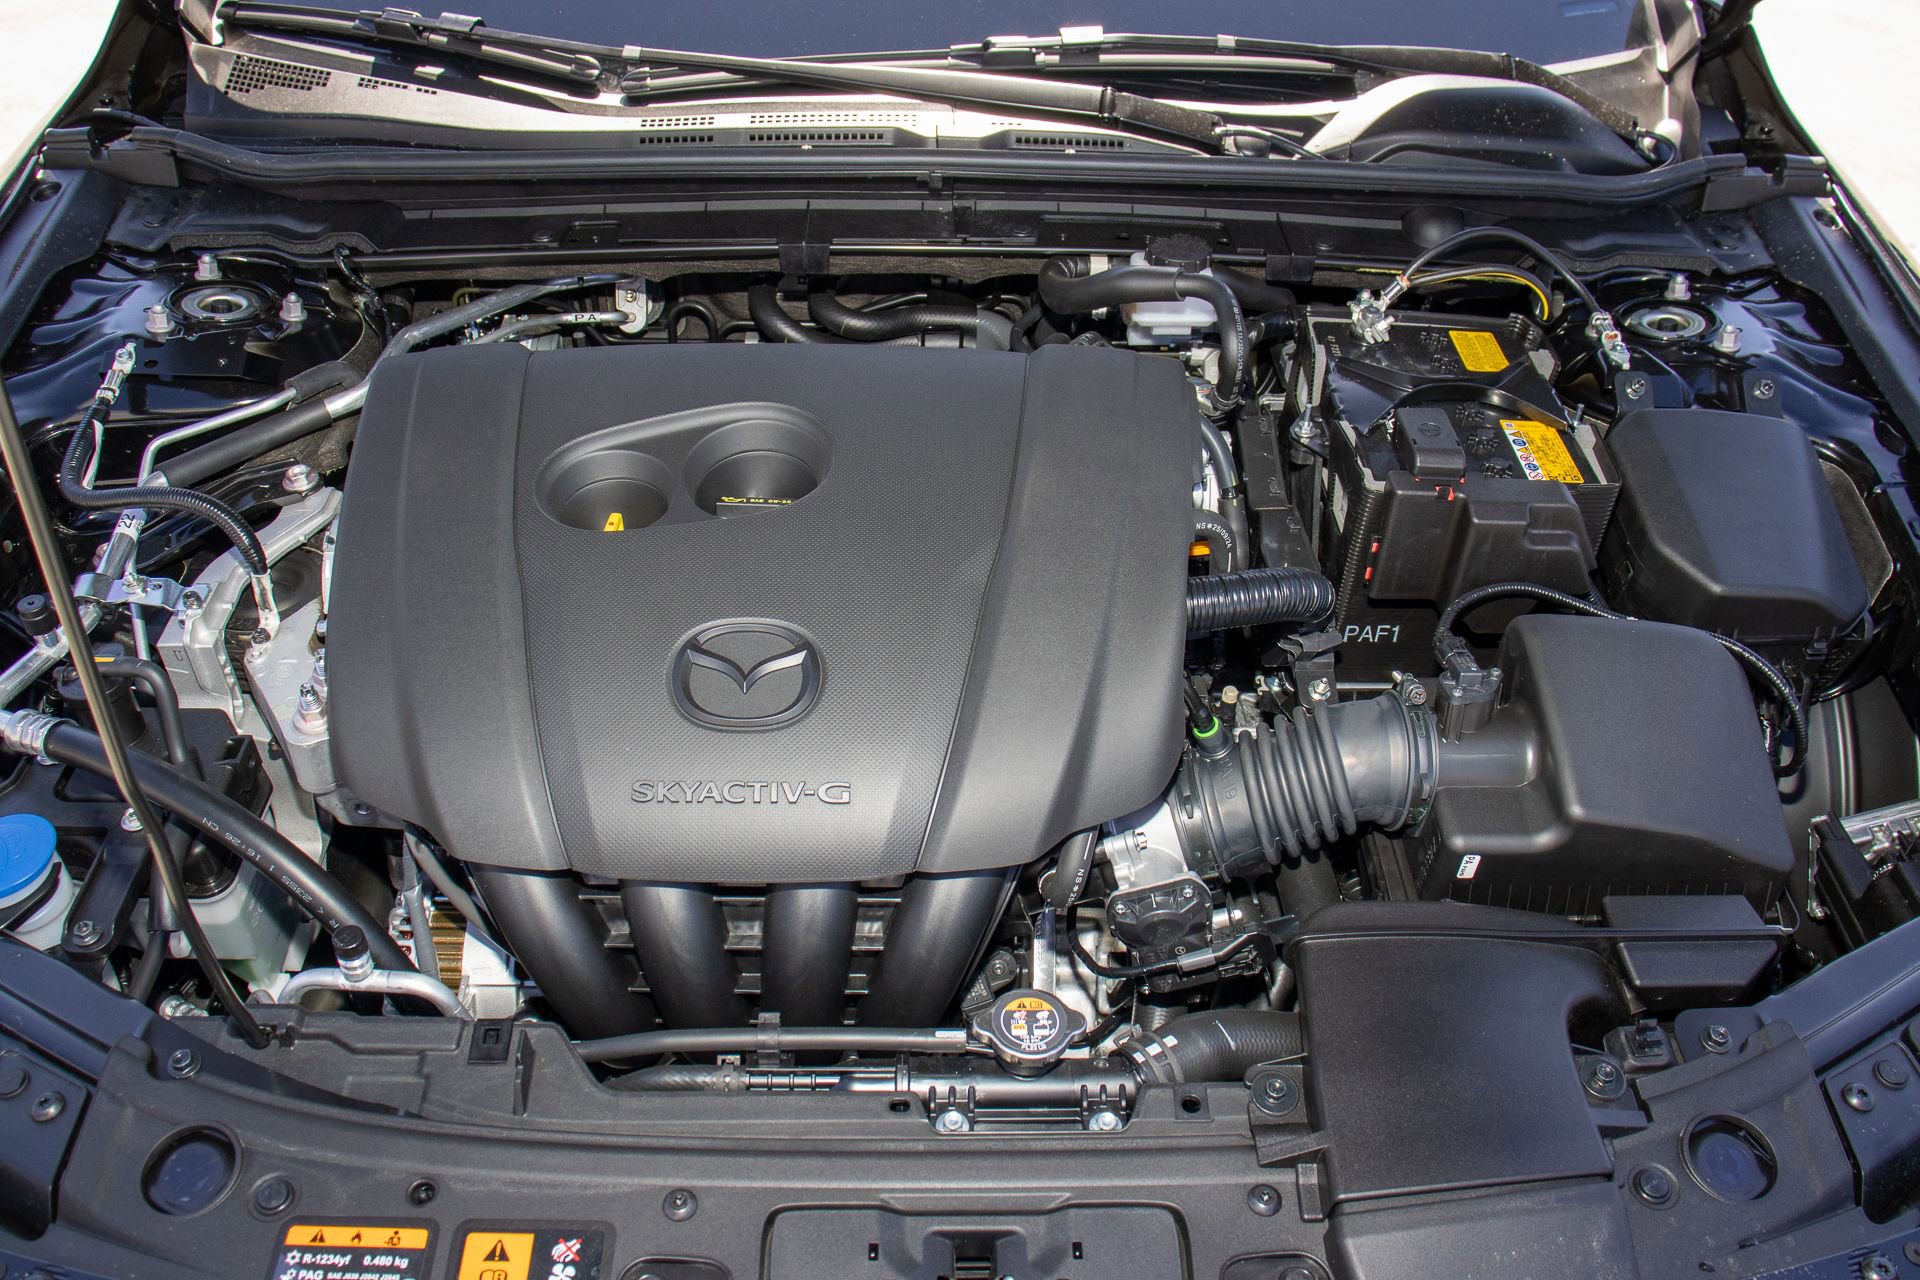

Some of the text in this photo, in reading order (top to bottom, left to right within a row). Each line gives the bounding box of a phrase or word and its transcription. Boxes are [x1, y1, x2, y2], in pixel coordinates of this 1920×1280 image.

[118, 513, 136, 529] 22
[1342, 624, 1400, 643] PAF1
[630, 779, 852, 805] SKYACTIV-G
[202, 817, 219, 832] CN
[302, 1253, 409, 1269] R-1234yf 0.480 kg
[298, 1269, 324, 1280] PAG
